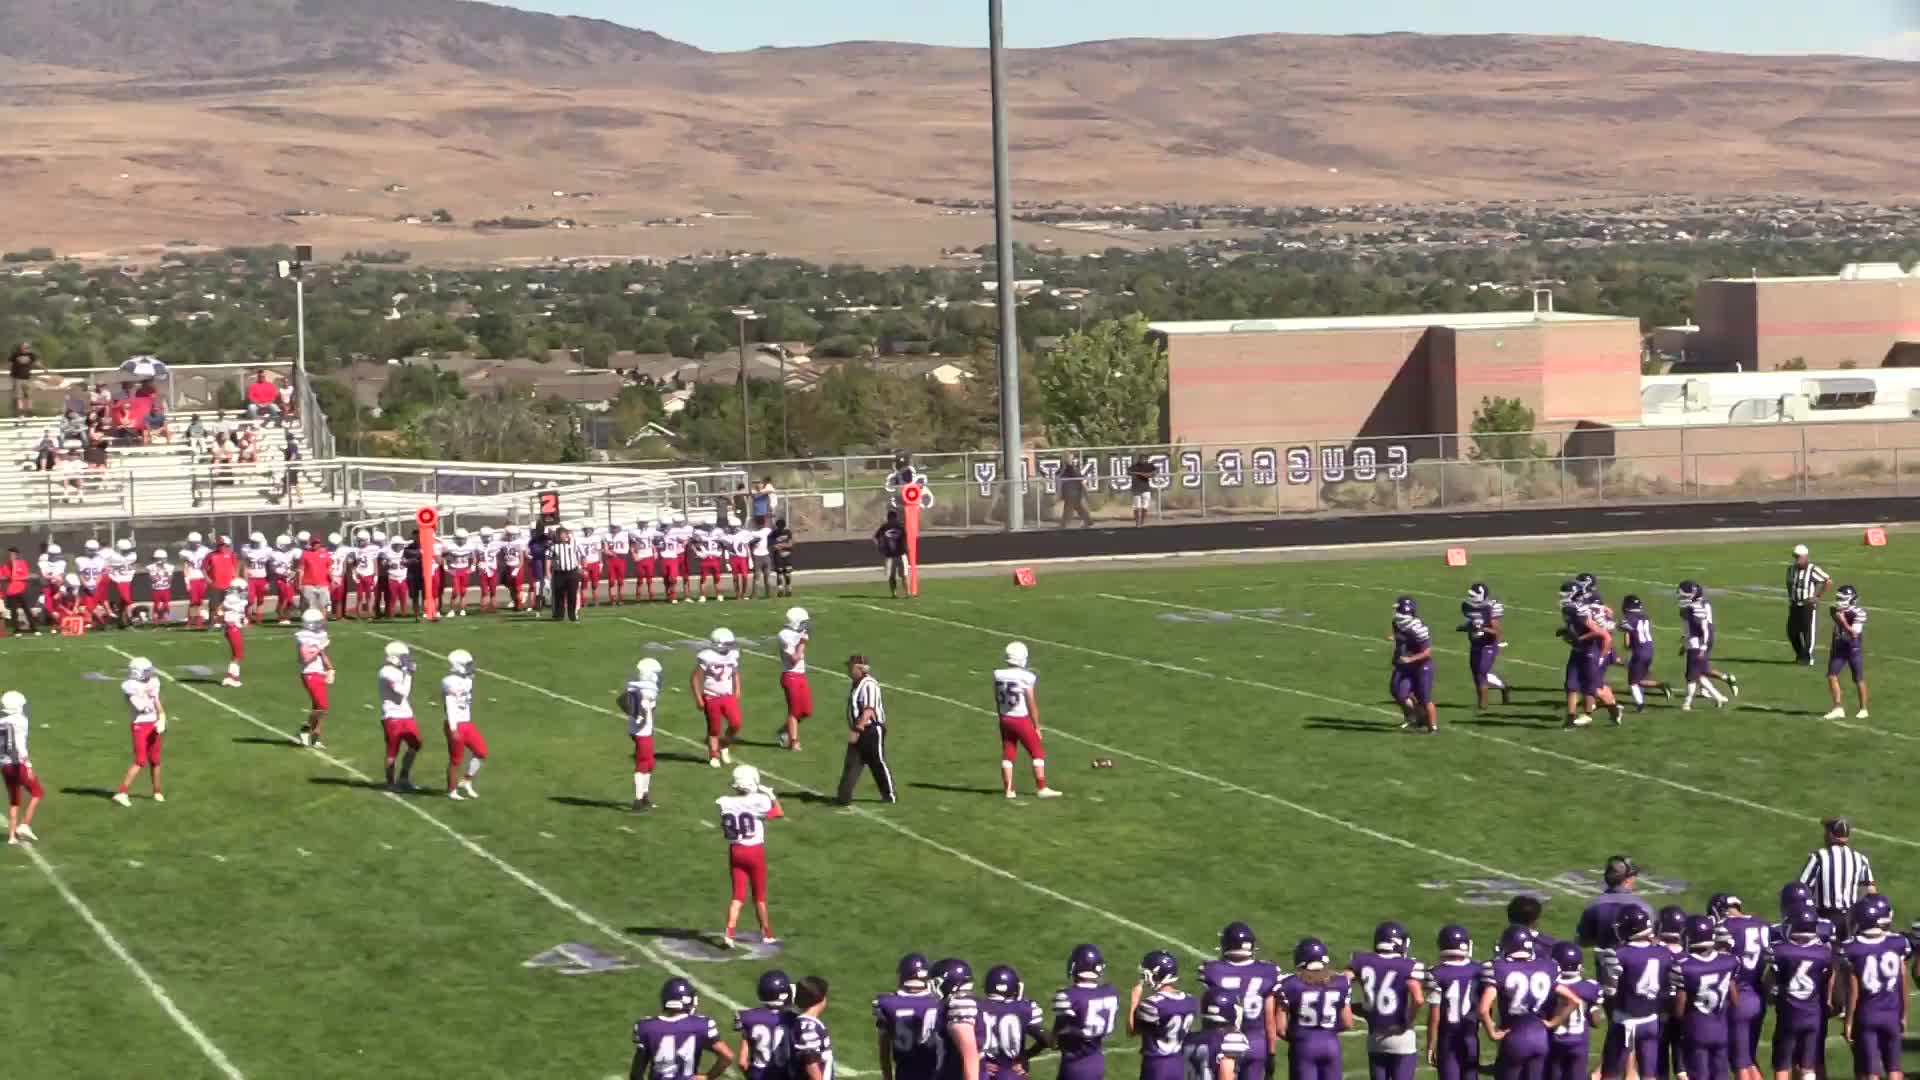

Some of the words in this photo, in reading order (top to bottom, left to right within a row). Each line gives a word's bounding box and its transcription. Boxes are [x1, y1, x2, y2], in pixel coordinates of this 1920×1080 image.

[543, 497, 556, 513] 2
[1360, 966, 1398, 1015] 36
[1505, 971, 1551, 1014] 29
[1636, 959, 1660, 999] 4
[1788, 960, 1815, 999] 6
[1862, 951, 1900, 993] 49
[1083, 996, 1118, 1037] 57
[1299, 991, 1342, 1028] 55
[654, 1034, 697, 1078] 41
